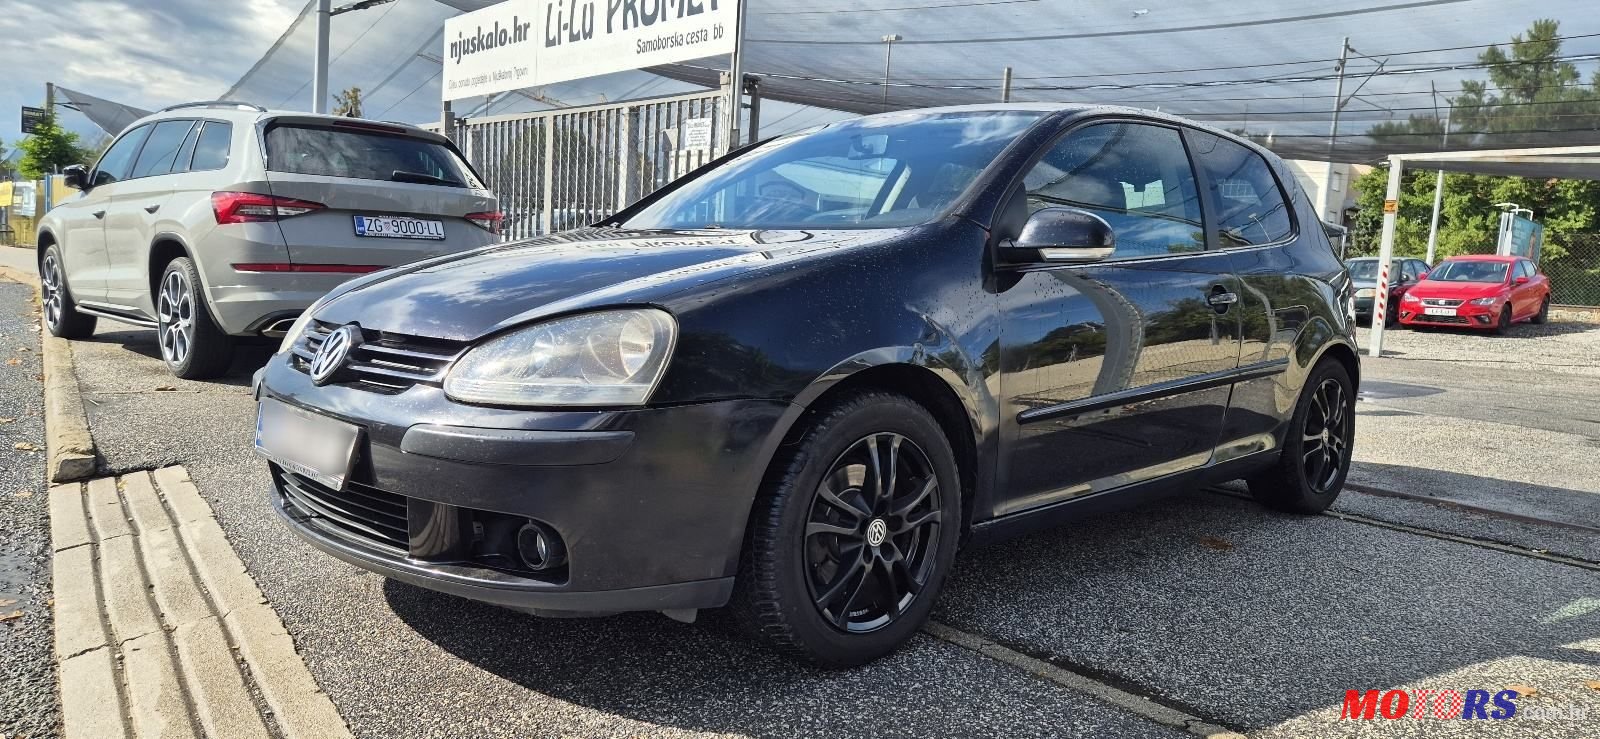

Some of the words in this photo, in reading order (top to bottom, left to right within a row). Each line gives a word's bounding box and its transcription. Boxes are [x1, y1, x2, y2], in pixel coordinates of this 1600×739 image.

[450, 15, 531, 65] njuskalo.hr
[545, 0, 594, 47] Li-Lu
[607, 0, 718, 33] PRO
[636, 32, 684, 54] Samoborska
[685, 28, 708, 45] cesta
[713, 23, 724, 40] bb
[365, 218, 383, 233] ZG
